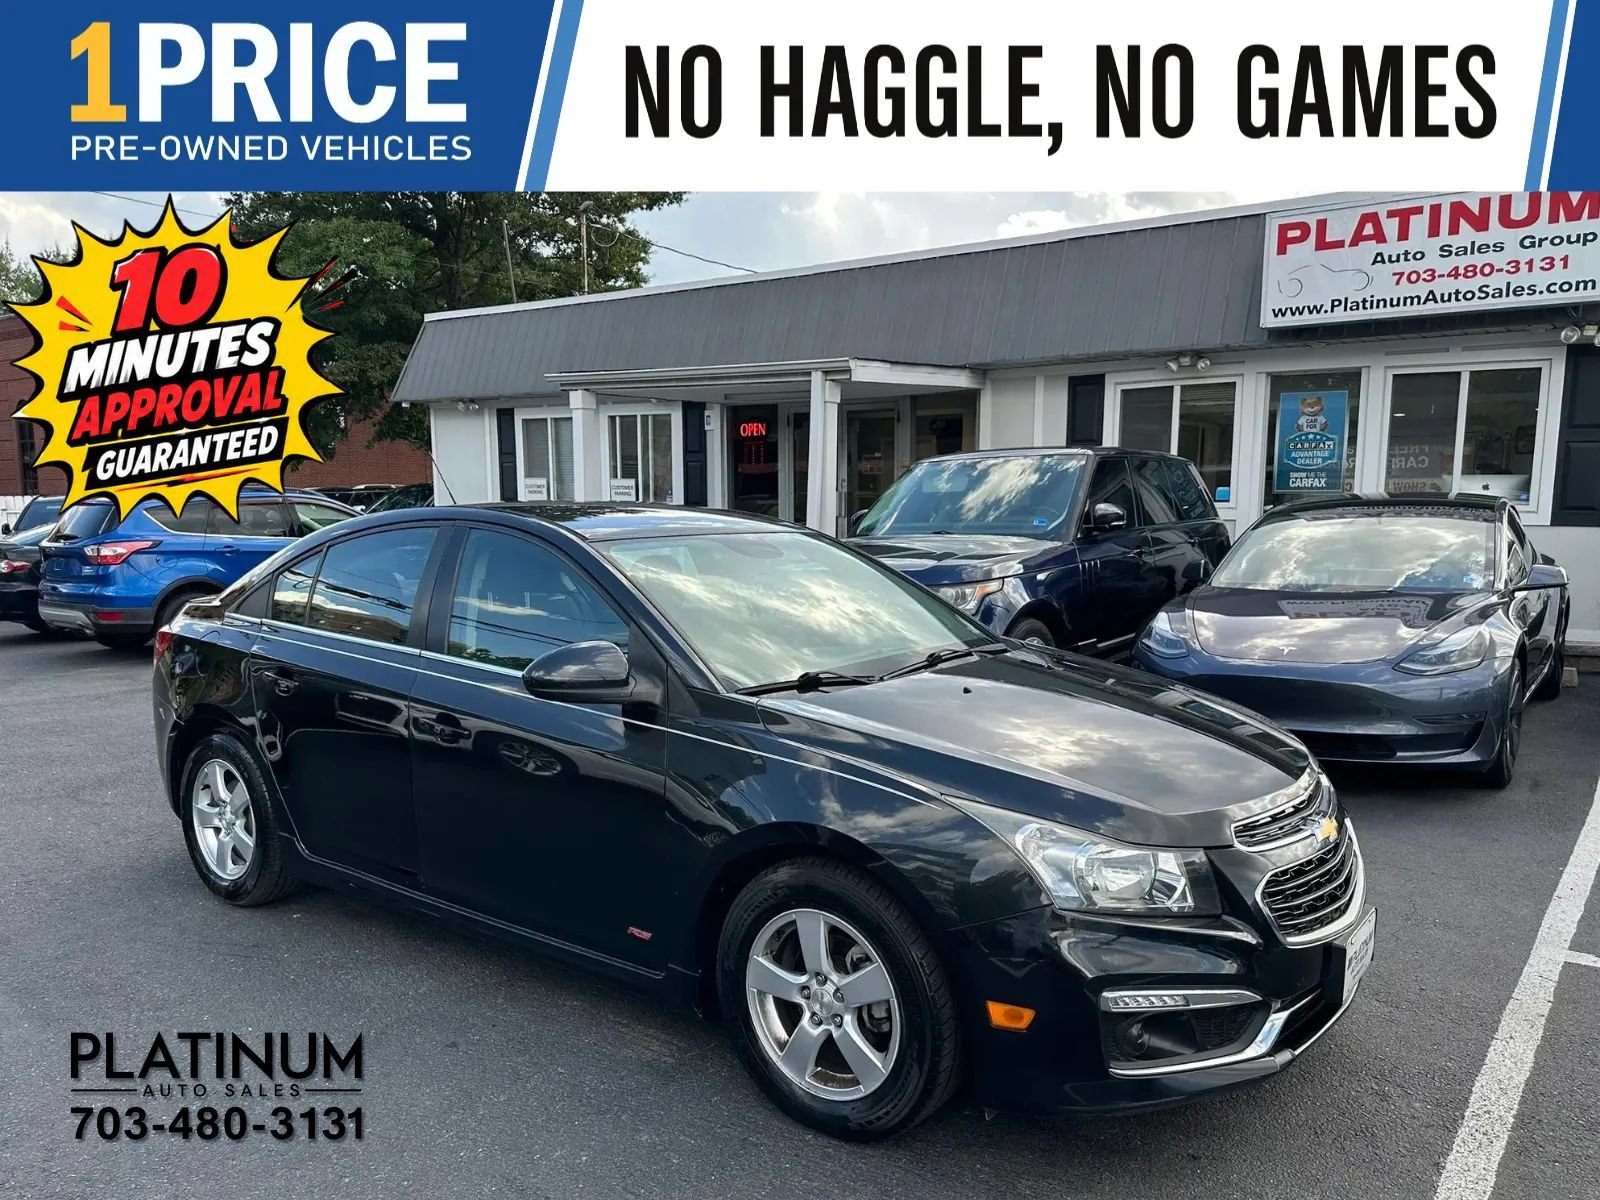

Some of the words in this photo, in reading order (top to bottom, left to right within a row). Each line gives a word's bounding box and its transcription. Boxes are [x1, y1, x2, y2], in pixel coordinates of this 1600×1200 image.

[1276, 191, 1600, 256] PLATINUM
[1371, 248, 1425, 266] Auto
[1438, 240, 1505, 258] Sales
[1519, 231, 1598, 250] Group
[1392, 255, 1569, 286] 703-480-3131
[1272, 278, 1597, 318] www.PlatinumAutoSales.com
[740, 423, 766, 437] OPEN
[1289, 441, 1333, 450] CARFAX
[1291, 450, 1329, 458] ADVANTAGE
[1289, 478, 1327, 488] CARFAX
